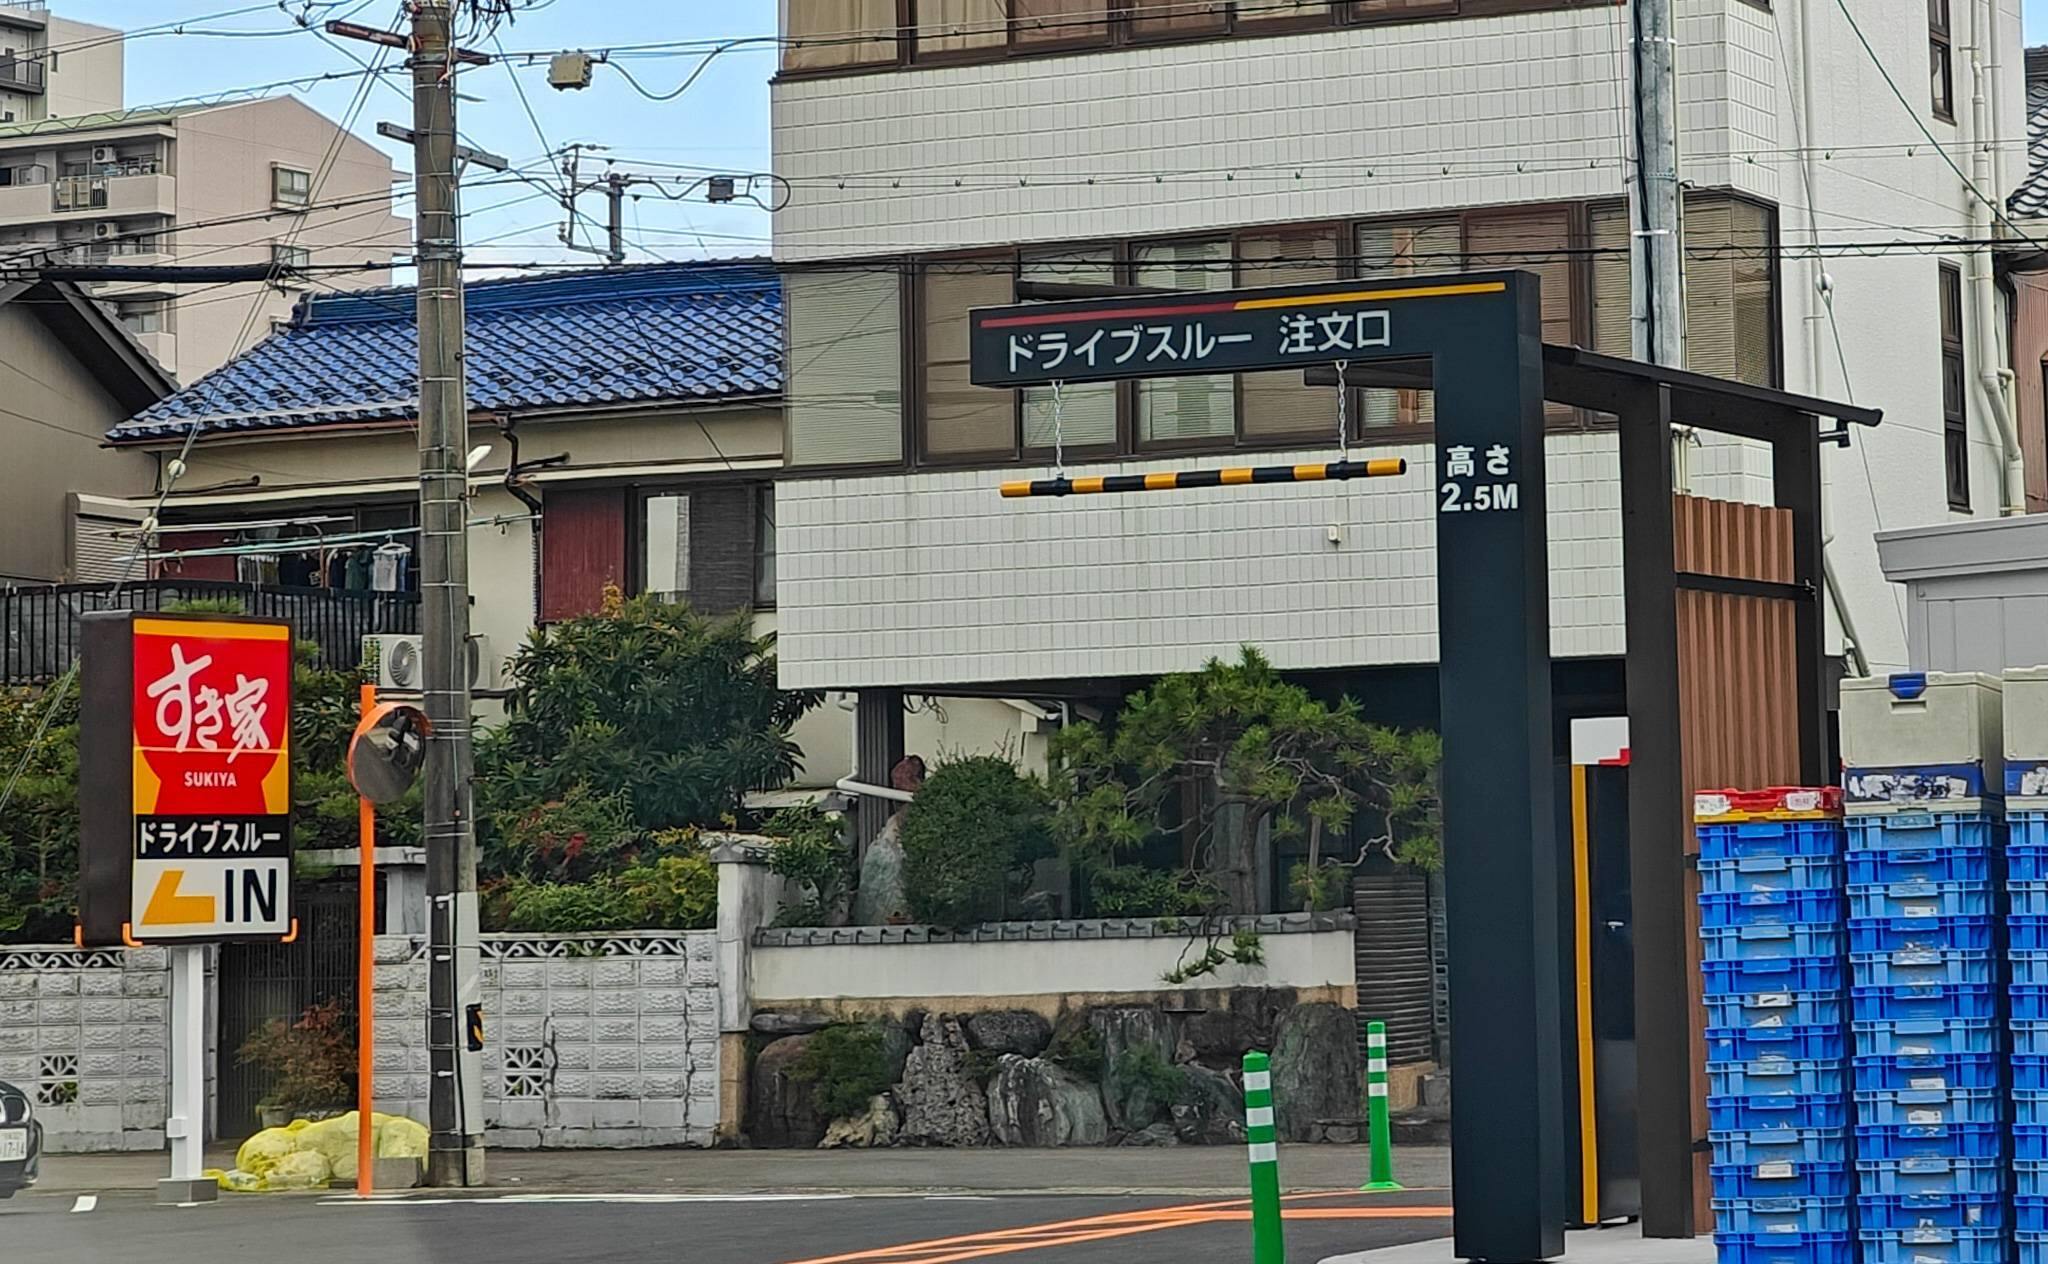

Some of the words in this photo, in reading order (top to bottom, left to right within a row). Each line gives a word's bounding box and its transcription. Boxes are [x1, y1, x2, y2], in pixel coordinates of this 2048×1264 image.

[1008, 322, 1254, 373] ドライブスルー
[1278, 309, 1391, 356] 注文口
[1445, 443, 1511, 479] 高さ
[1440, 482, 1519, 513] 2.5M
[146, 642, 269, 764] すき家
[184, 771, 237, 788] SUKIYA
[139, 821, 281, 854] ドライブスルー
[224, 868, 277, 923] IN
